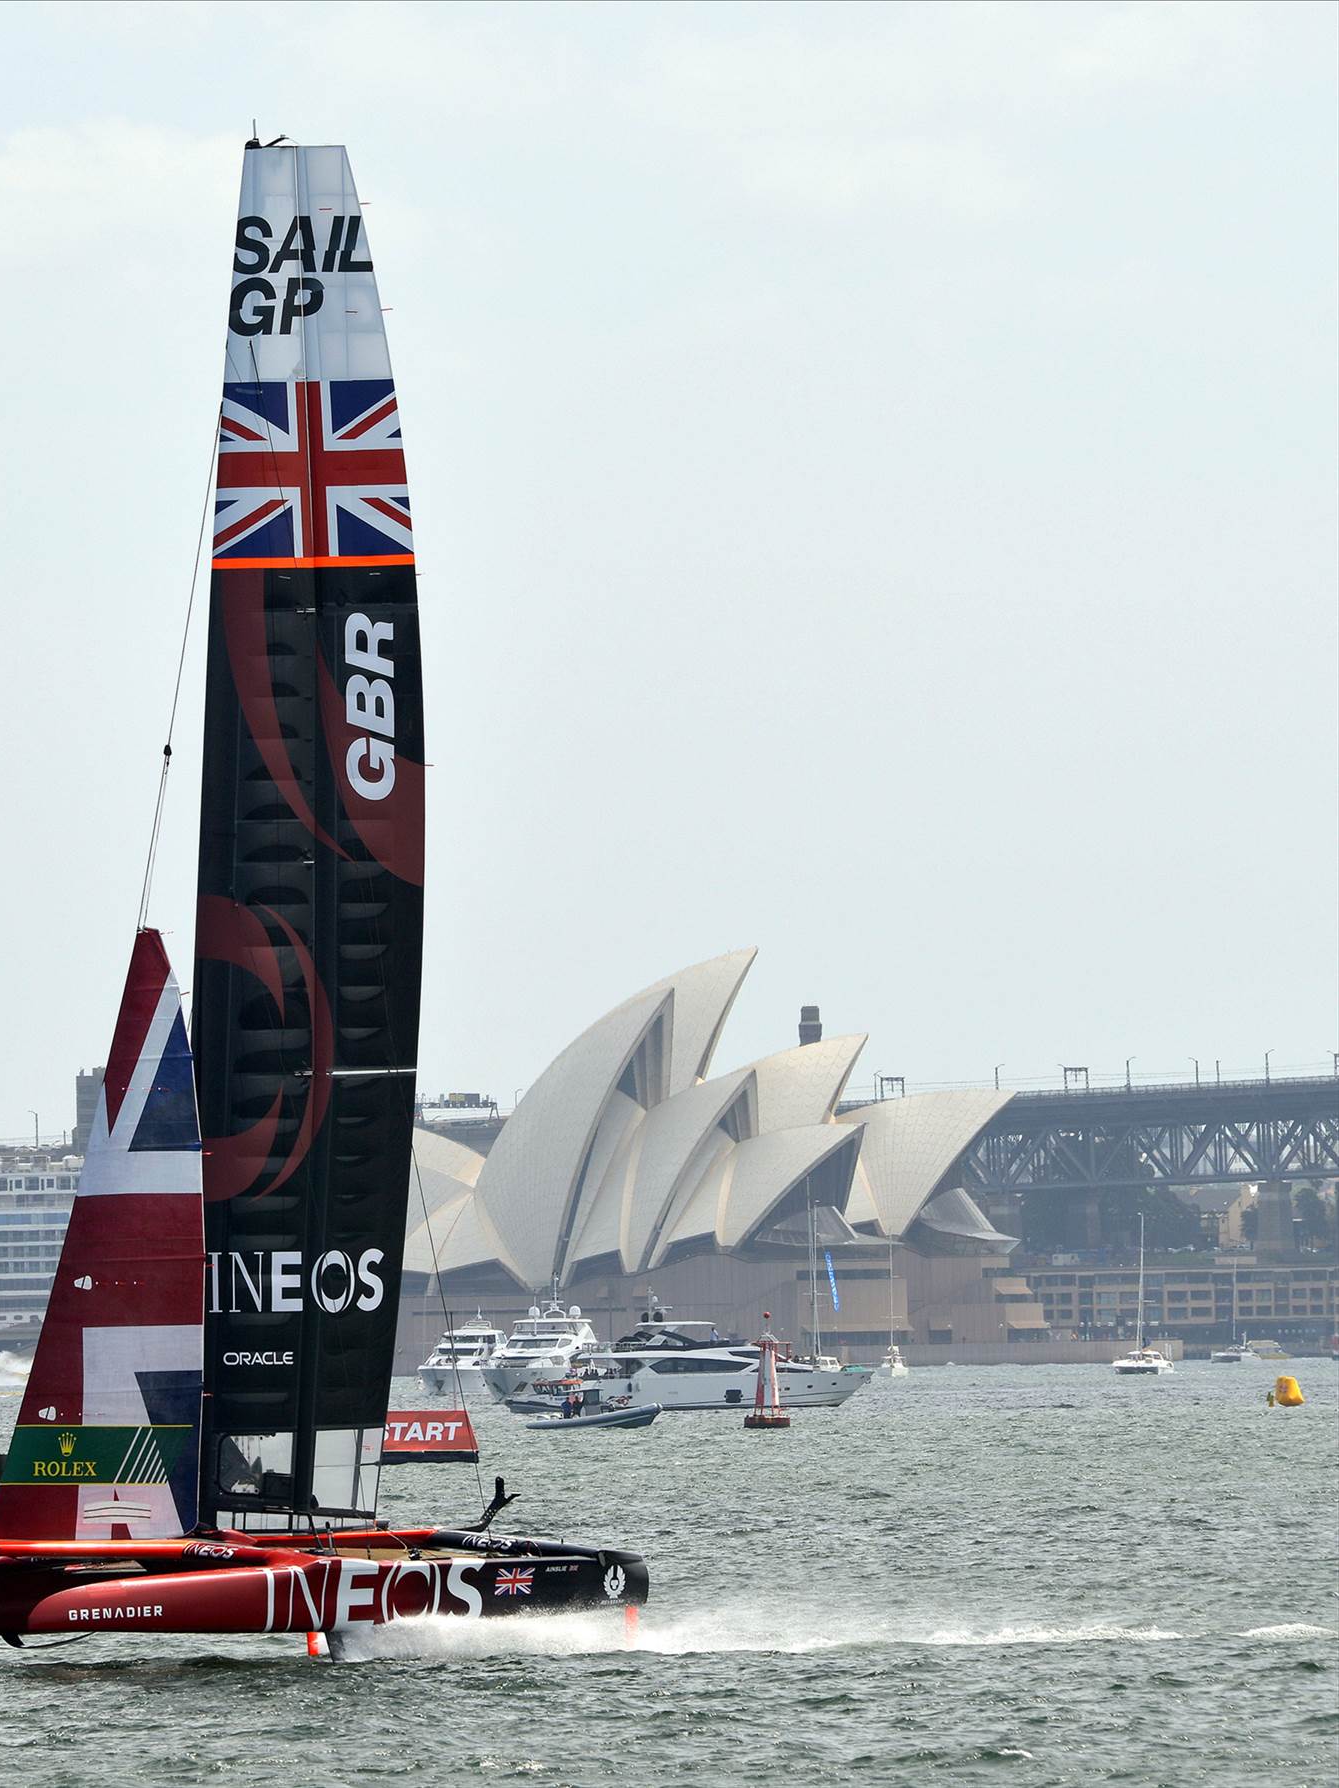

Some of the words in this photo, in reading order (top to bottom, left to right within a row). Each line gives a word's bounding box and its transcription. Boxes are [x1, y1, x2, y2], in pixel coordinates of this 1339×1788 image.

[233, 215, 374, 274] SAIL
[228, 277, 324, 336] GP
[345, 612, 396, 801] GBR
[207, 1248, 385, 1313] INEOS
[223, 1351, 294, 1365] ORACLE
[33, 1461, 97, 1477] ROLEX
[184, 1543, 238, 1559] INEOS
[462, 1535, 516, 1550] INEOS
[68, 1605, 163, 1621] GRENADIER
[262, 1558, 486, 1632] INEOS
